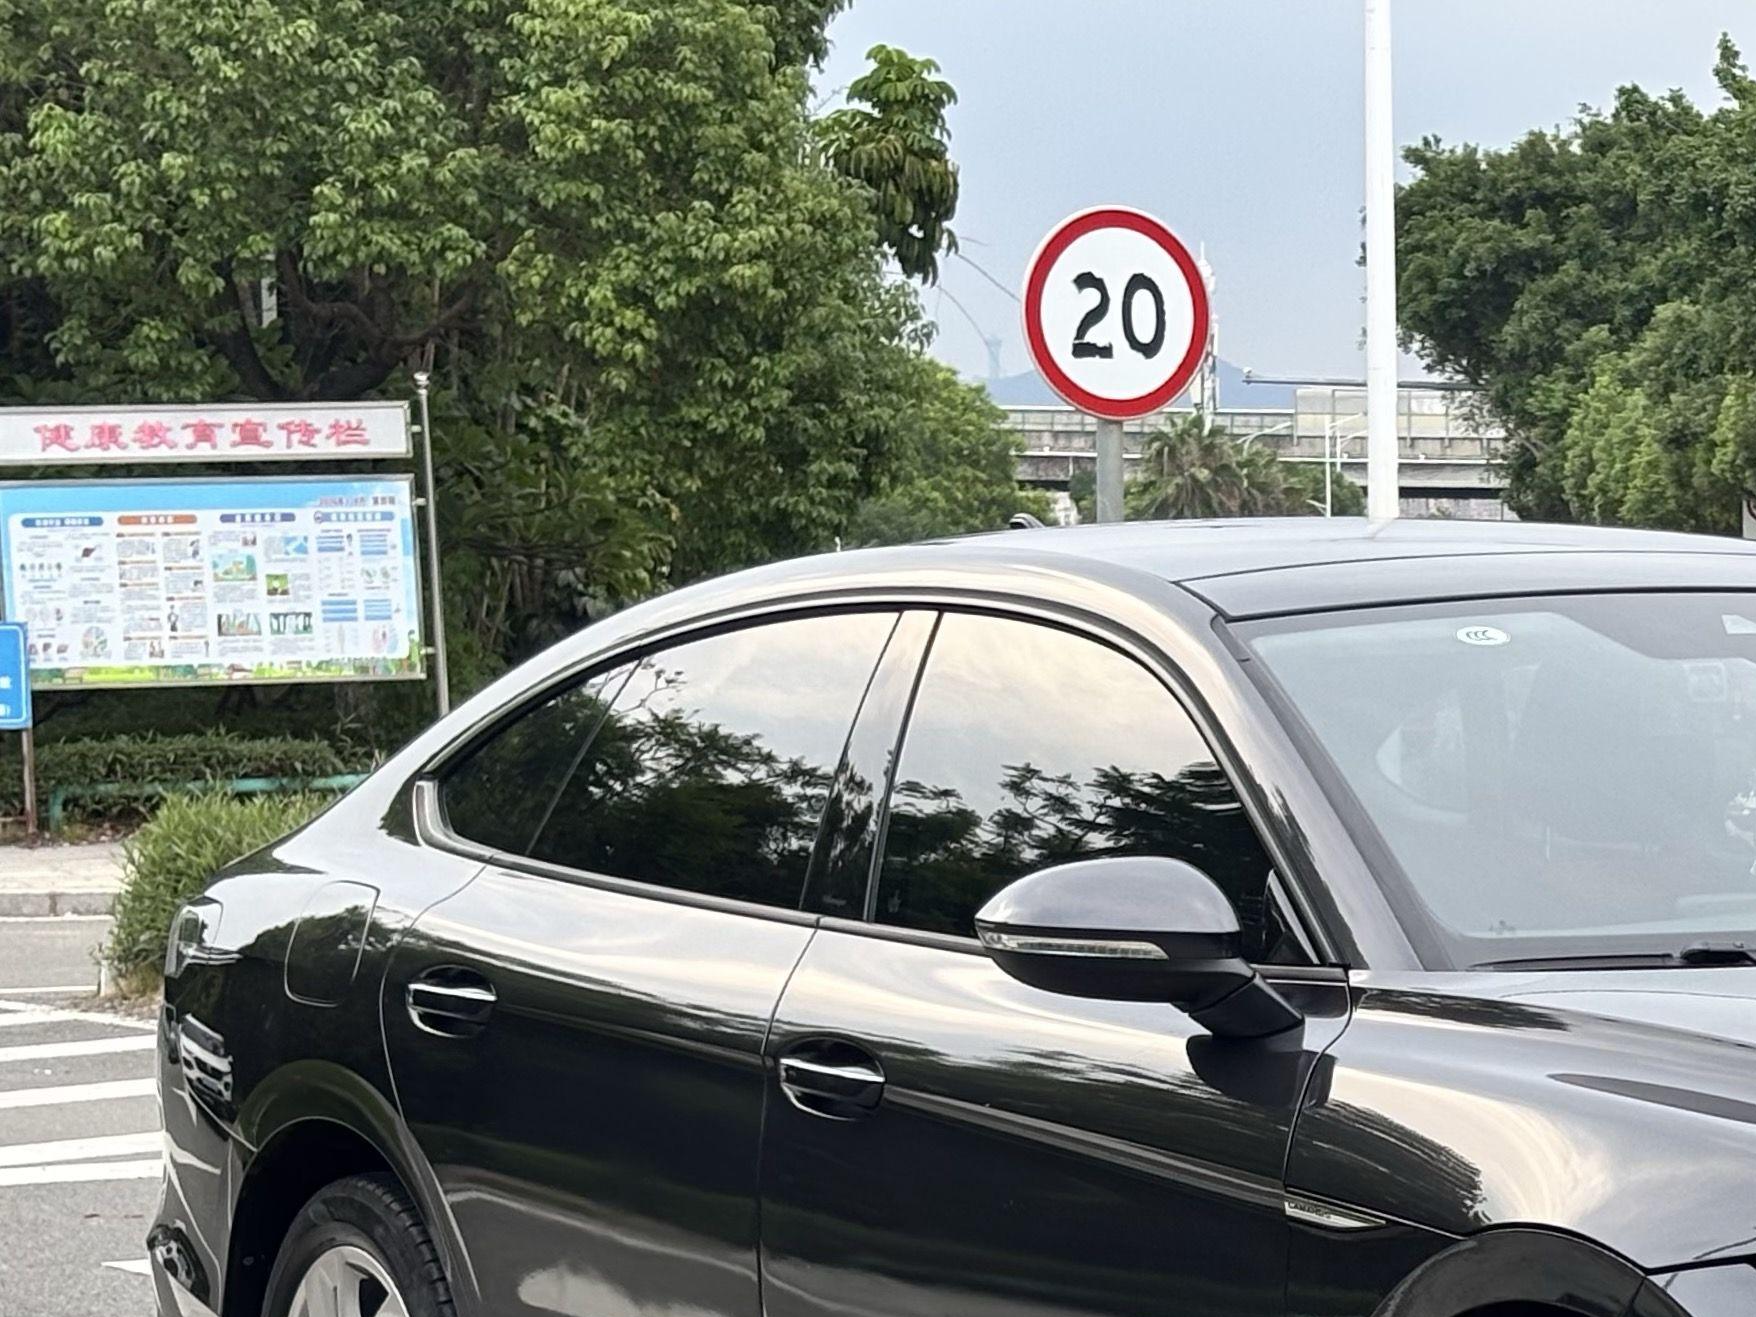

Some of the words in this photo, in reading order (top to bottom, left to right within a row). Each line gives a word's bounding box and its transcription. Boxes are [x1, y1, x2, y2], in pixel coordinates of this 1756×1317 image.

[1071, 271, 1166, 360] 20
[33, 417, 371, 452] 健康教育宣传栏
